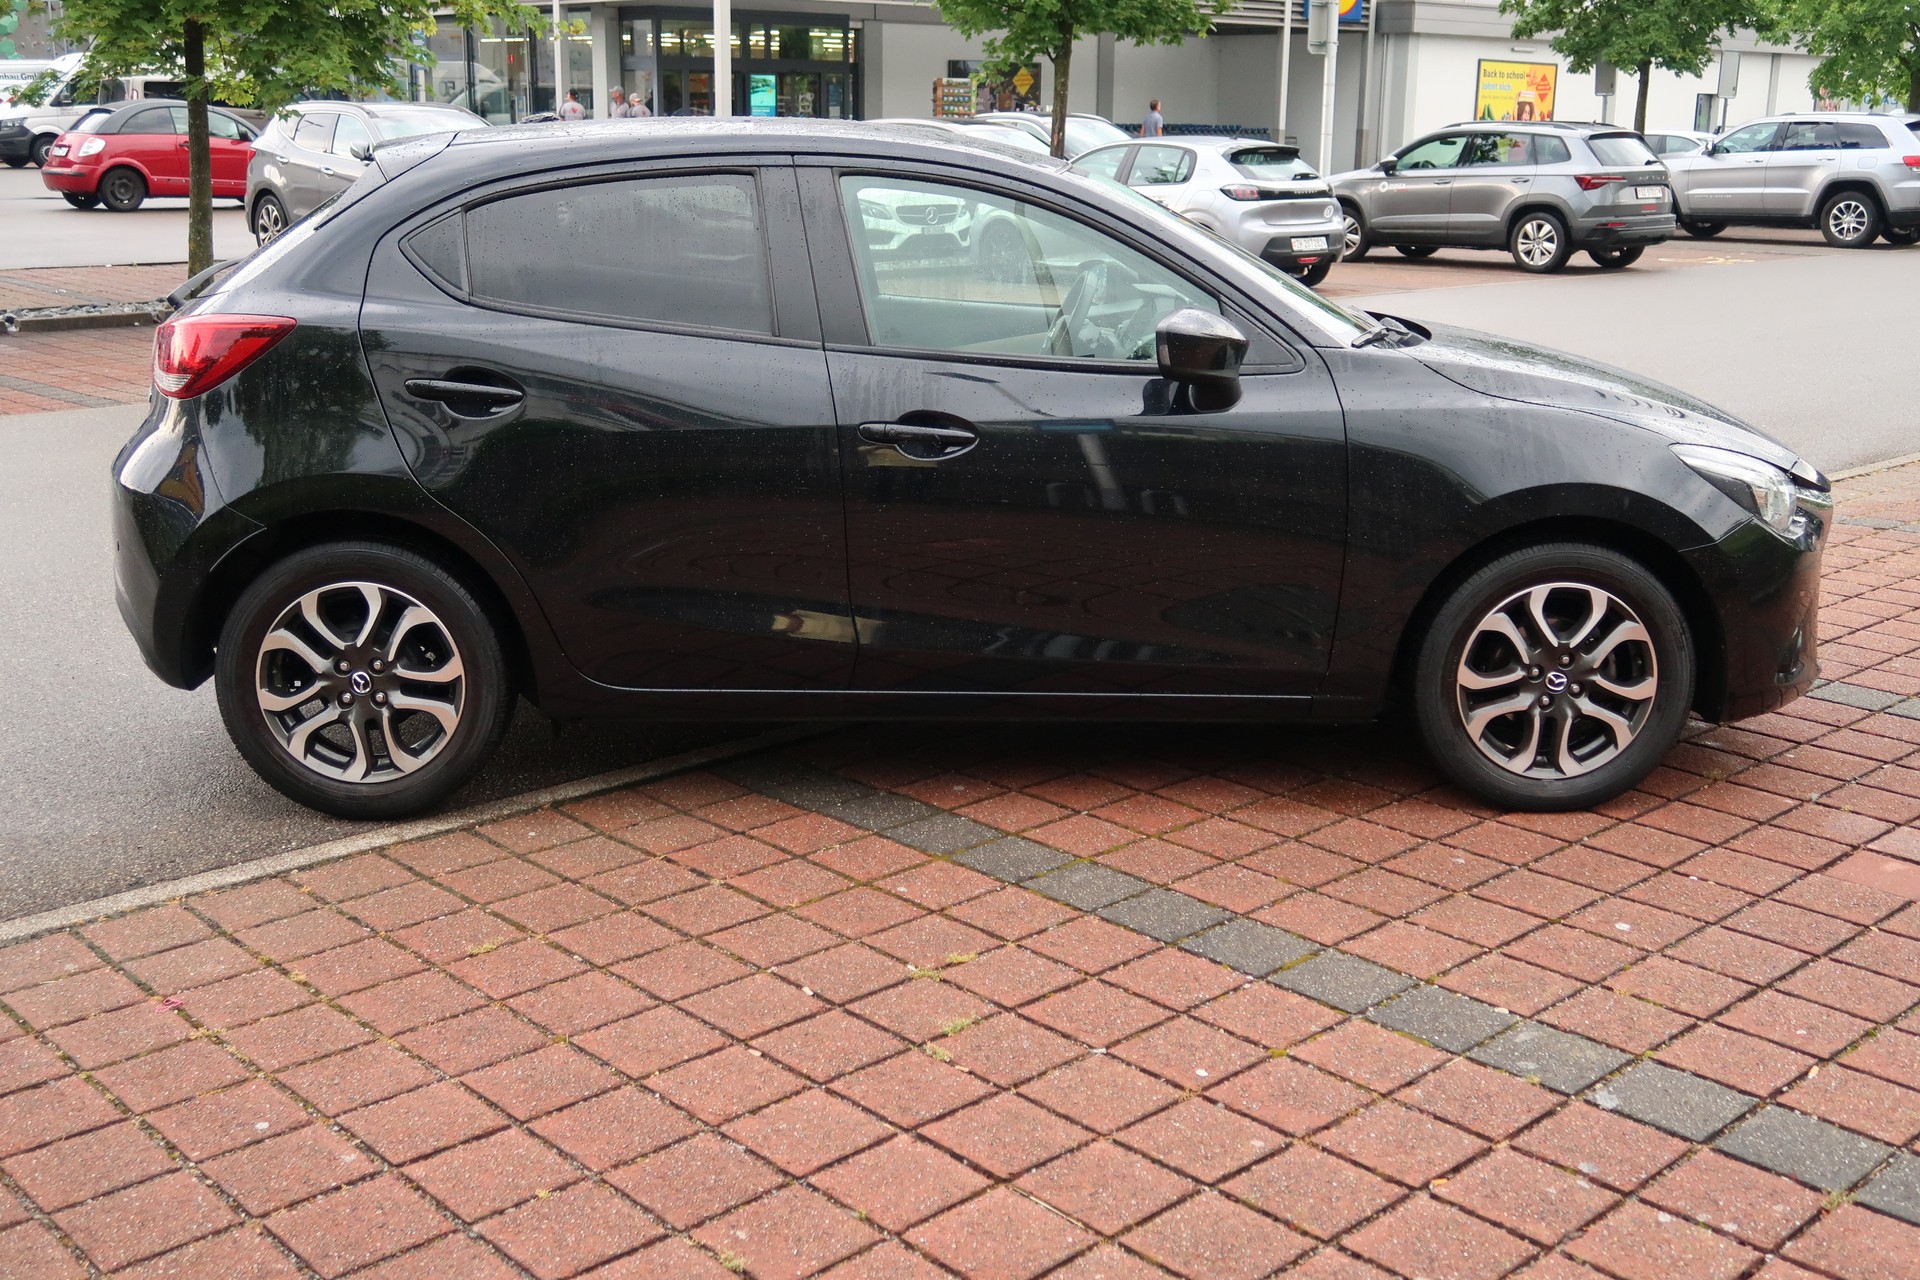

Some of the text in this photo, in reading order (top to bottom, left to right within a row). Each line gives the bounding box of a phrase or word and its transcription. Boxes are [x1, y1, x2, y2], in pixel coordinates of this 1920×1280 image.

[1483, 69, 1526, 80] Back to school
